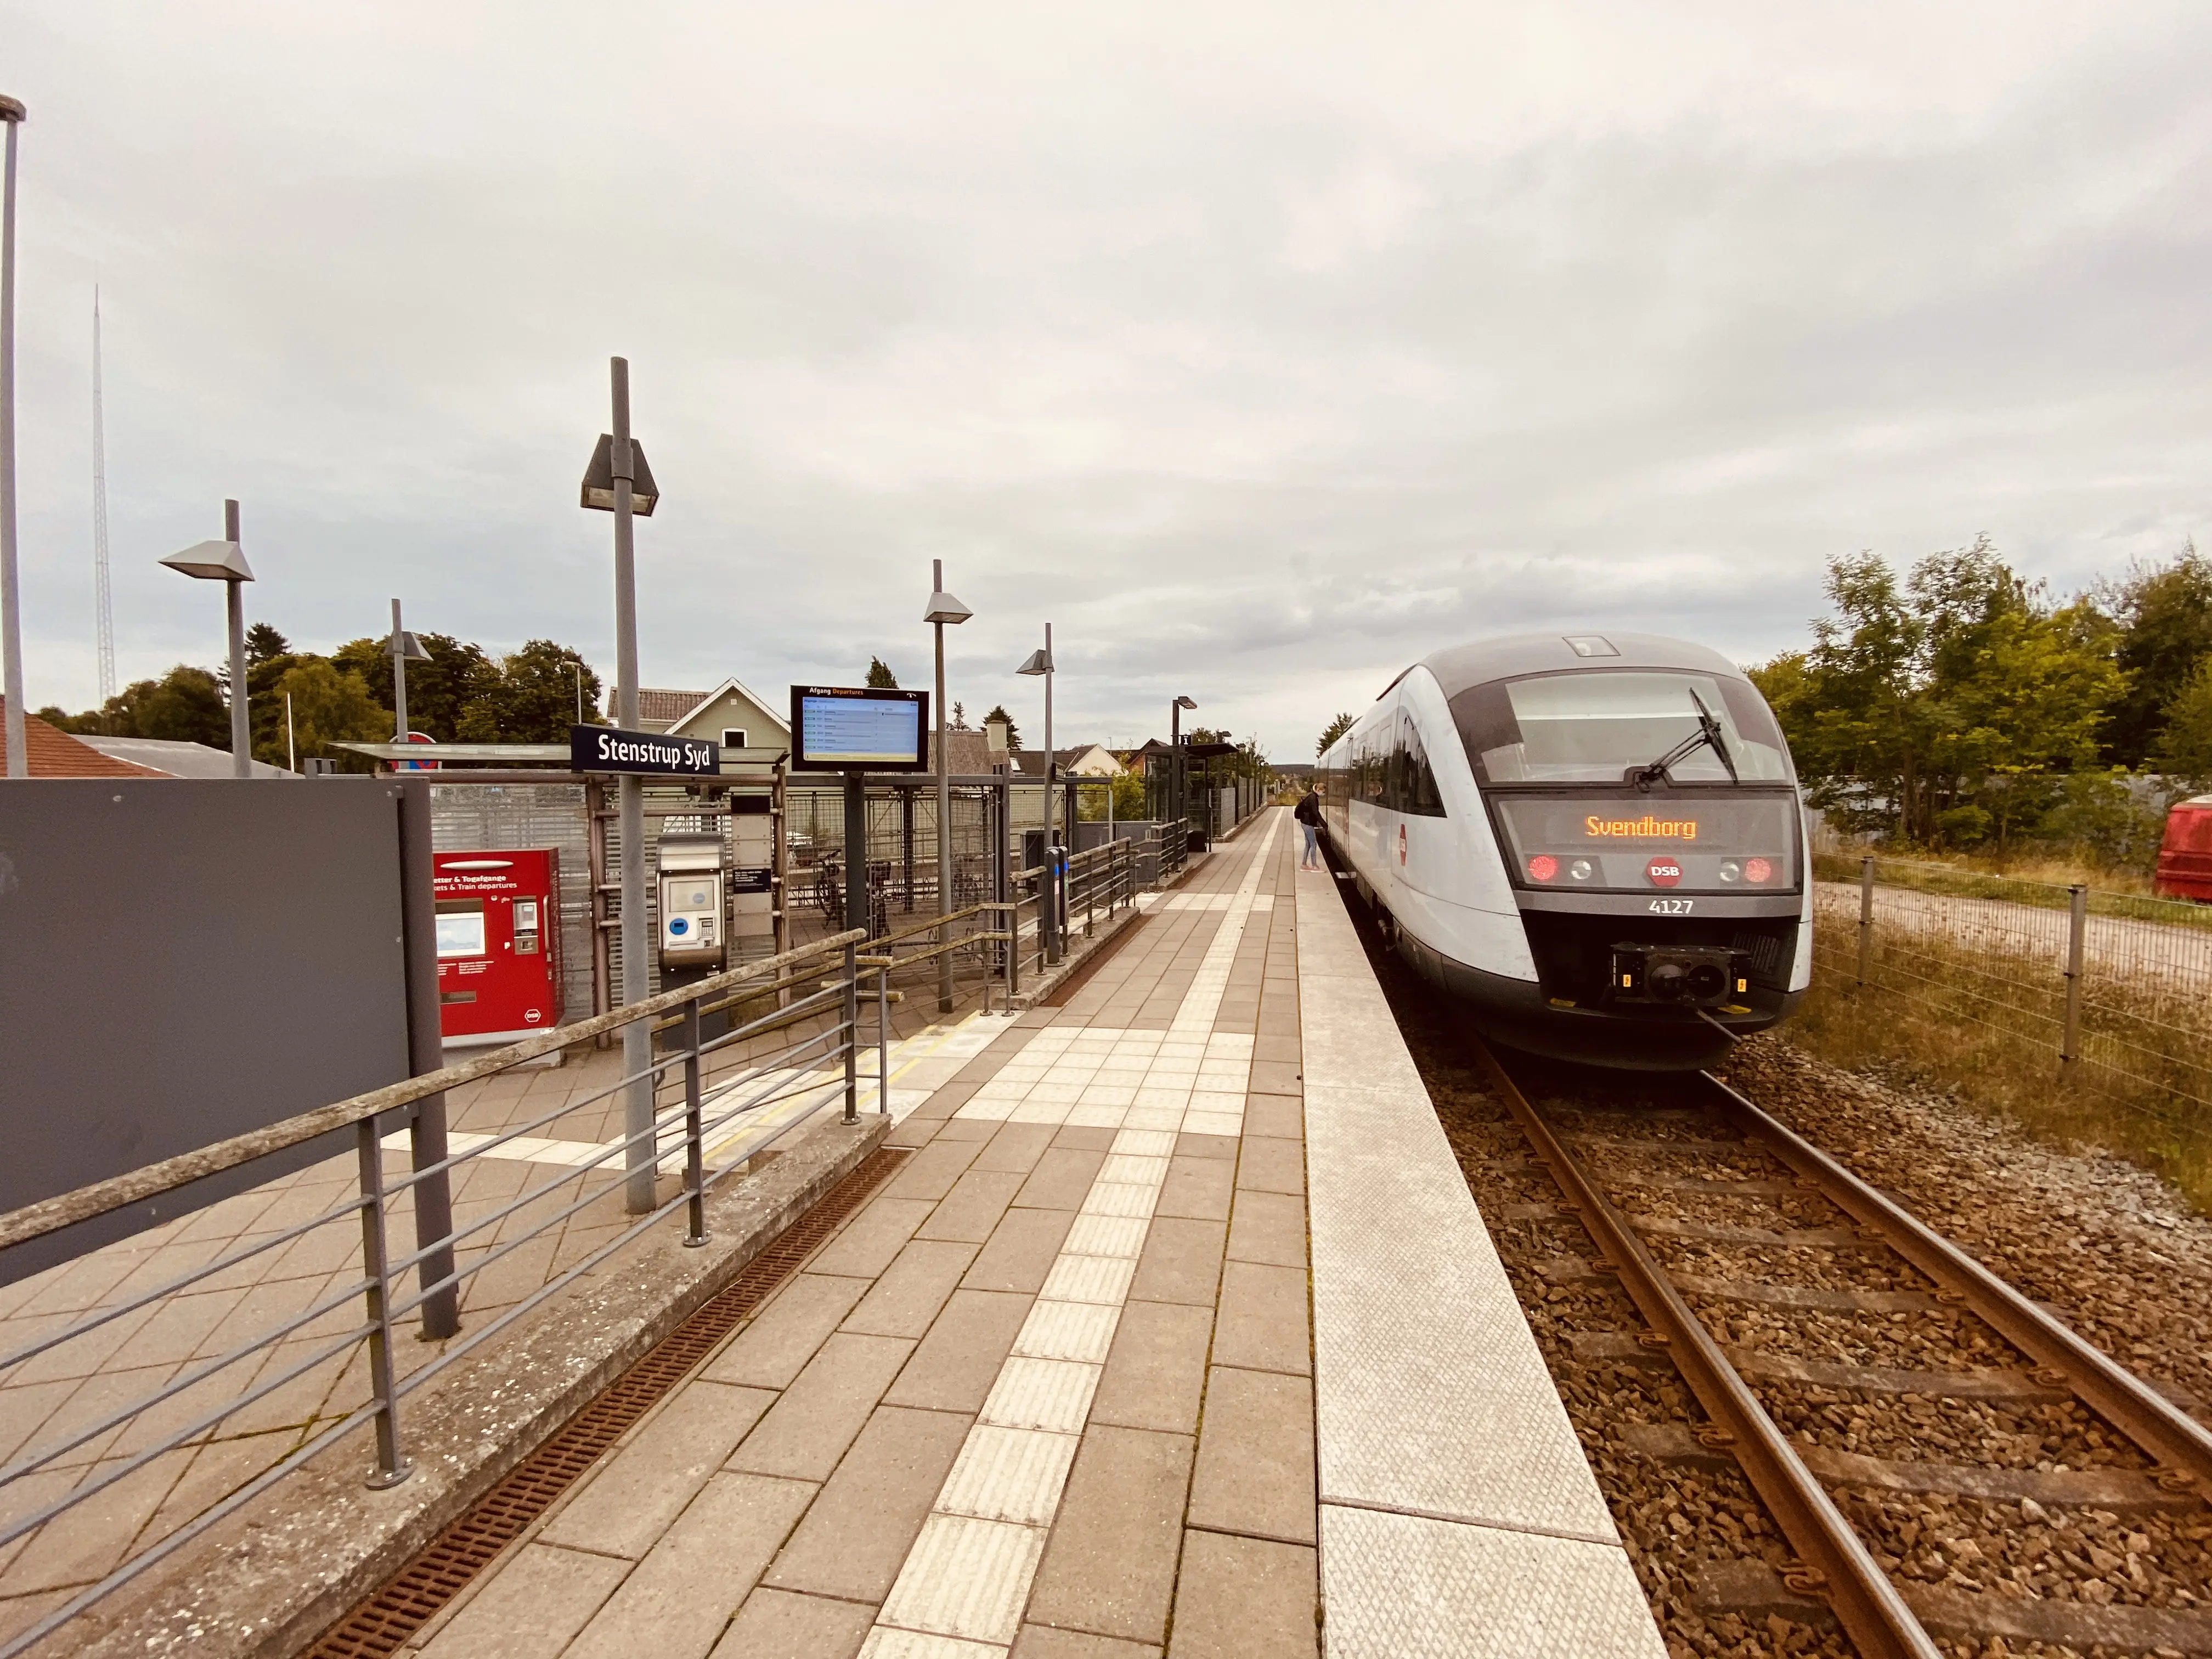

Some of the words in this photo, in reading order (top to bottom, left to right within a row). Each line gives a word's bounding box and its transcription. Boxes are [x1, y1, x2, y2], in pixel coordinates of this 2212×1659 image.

[809, 687, 831, 695] Afgang
[599, 734, 680, 769] Stenstrup
[685, 743, 710, 771] Syd
[1585, 816, 1697, 839] Svendborg
[1651, 866, 1680, 877] DSB
[1649, 900, 1694, 914] 4127
